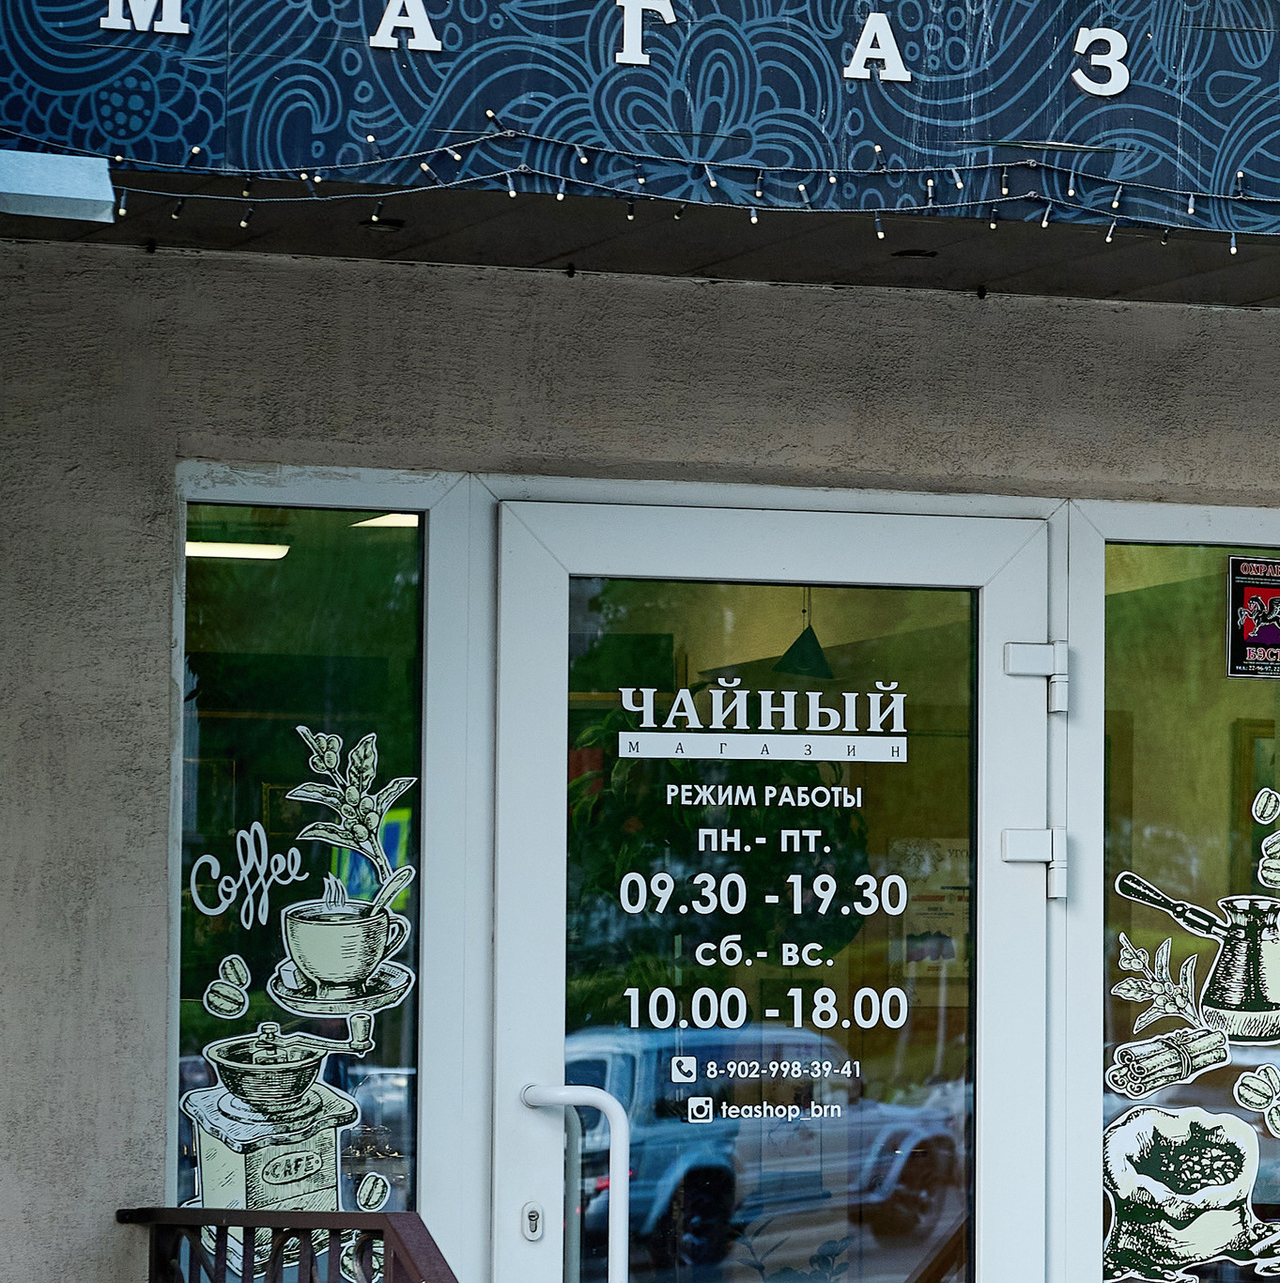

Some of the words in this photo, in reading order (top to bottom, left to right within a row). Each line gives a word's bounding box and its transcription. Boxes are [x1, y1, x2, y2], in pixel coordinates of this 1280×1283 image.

[618, 677, 908, 733] ЧАЙНЫЙ
[627, 740, 901, 758] МАГАЗИН
[665, 784, 757, 806] РЕЖИМ
[764, 785, 862, 808] РАБОТЫ
[190, 821, 310, 930] Coffee
[619, 872, 748, 914] 09.30
[623, 987, 748, 1030] 10.00
[705, 1060, 862, 1079] 8-902-998-39-41
[720, 1100, 842, 1122] teashop_brn
[271, 1155, 315, 1178] CAFE
